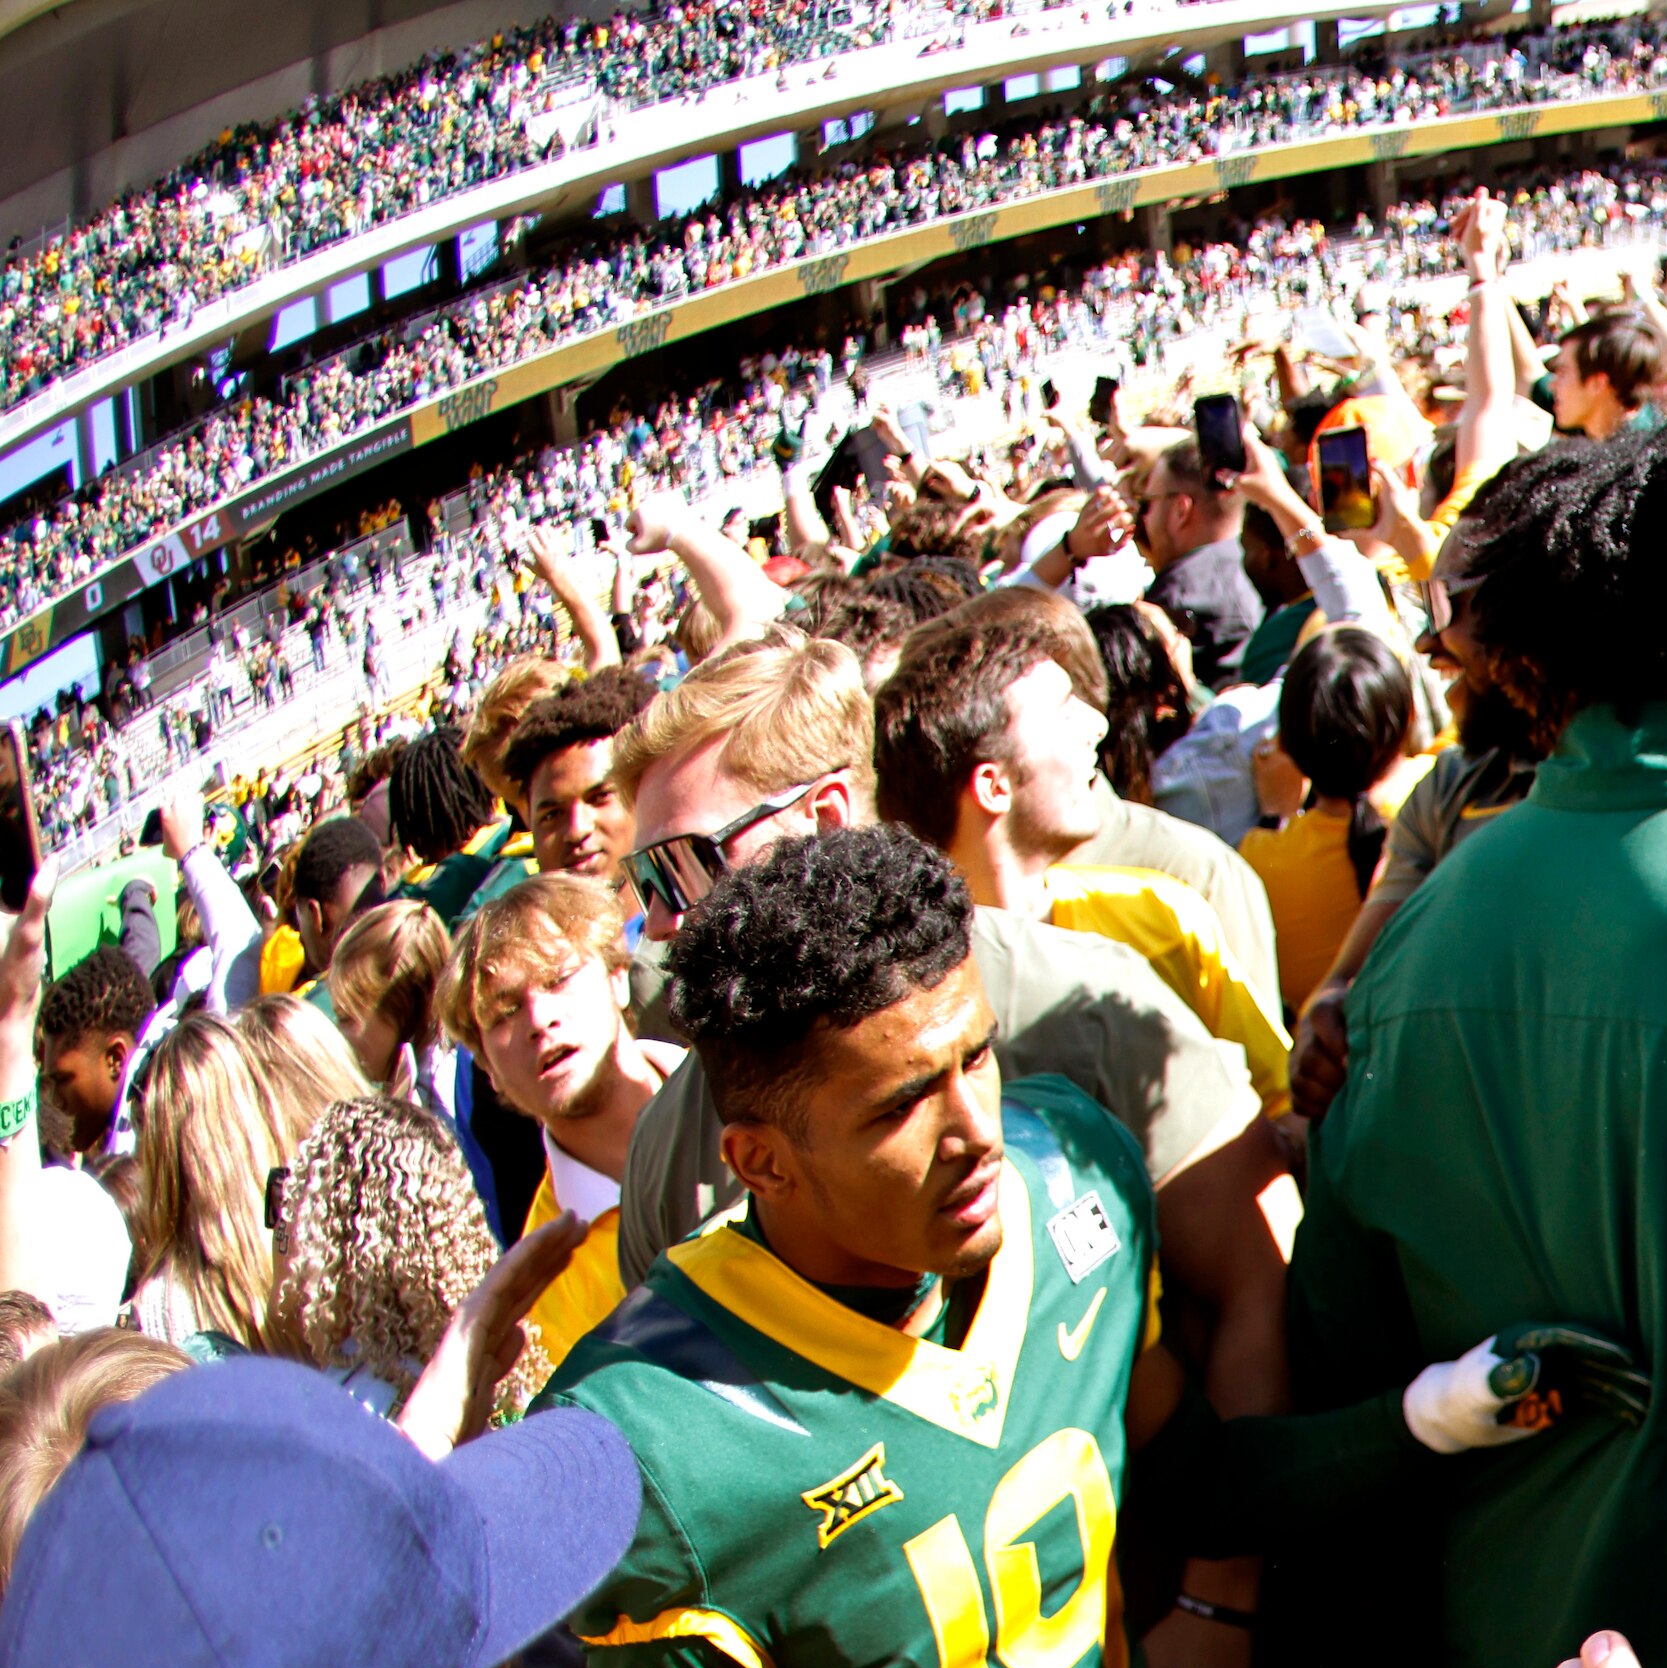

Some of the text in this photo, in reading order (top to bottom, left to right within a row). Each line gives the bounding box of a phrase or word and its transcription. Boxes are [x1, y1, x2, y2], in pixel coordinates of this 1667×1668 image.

[240, 426, 410, 521] BRANDING MADE TANGIBLE
[190, 514, 221, 550] 14
[85, 581, 104, 613] 0
